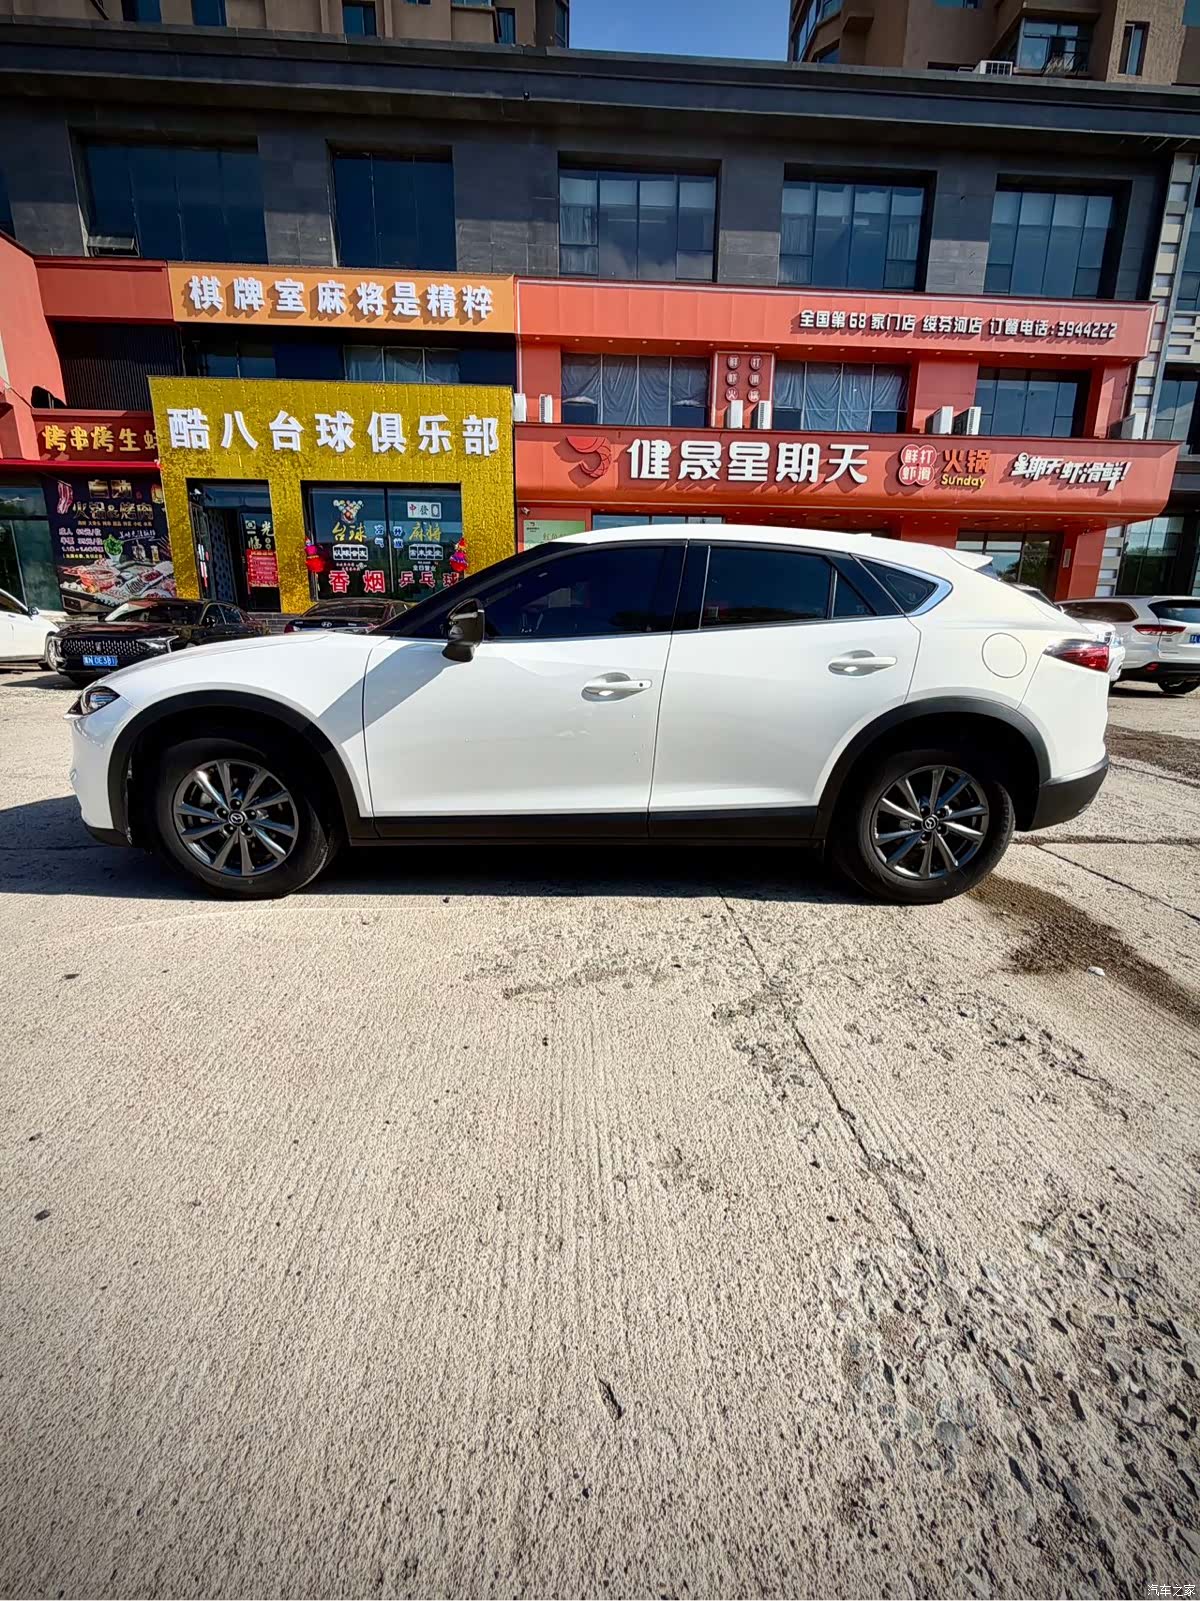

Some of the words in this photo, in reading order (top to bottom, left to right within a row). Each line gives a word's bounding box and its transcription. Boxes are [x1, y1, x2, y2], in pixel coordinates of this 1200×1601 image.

[188, 275, 494, 319] 棋牌室麻将是精粹
[922, 315, 983, 334] 绥芬河店
[166, 408, 499, 456] 酷八台球俱乐部
[626, 438, 870, 484] 健晟星期天
[904, 449, 934, 465] 鲜打
[942, 449, 992, 474] 火锅
[902, 466, 932, 482] 虾滑
[940, 474, 986, 489] Sunday
[332, 521, 367, 542] 台球
[408, 521, 442, 542] 麻将
[328, 570, 386, 593] 香烟
[398, 570, 460, 588] 乒乓球
